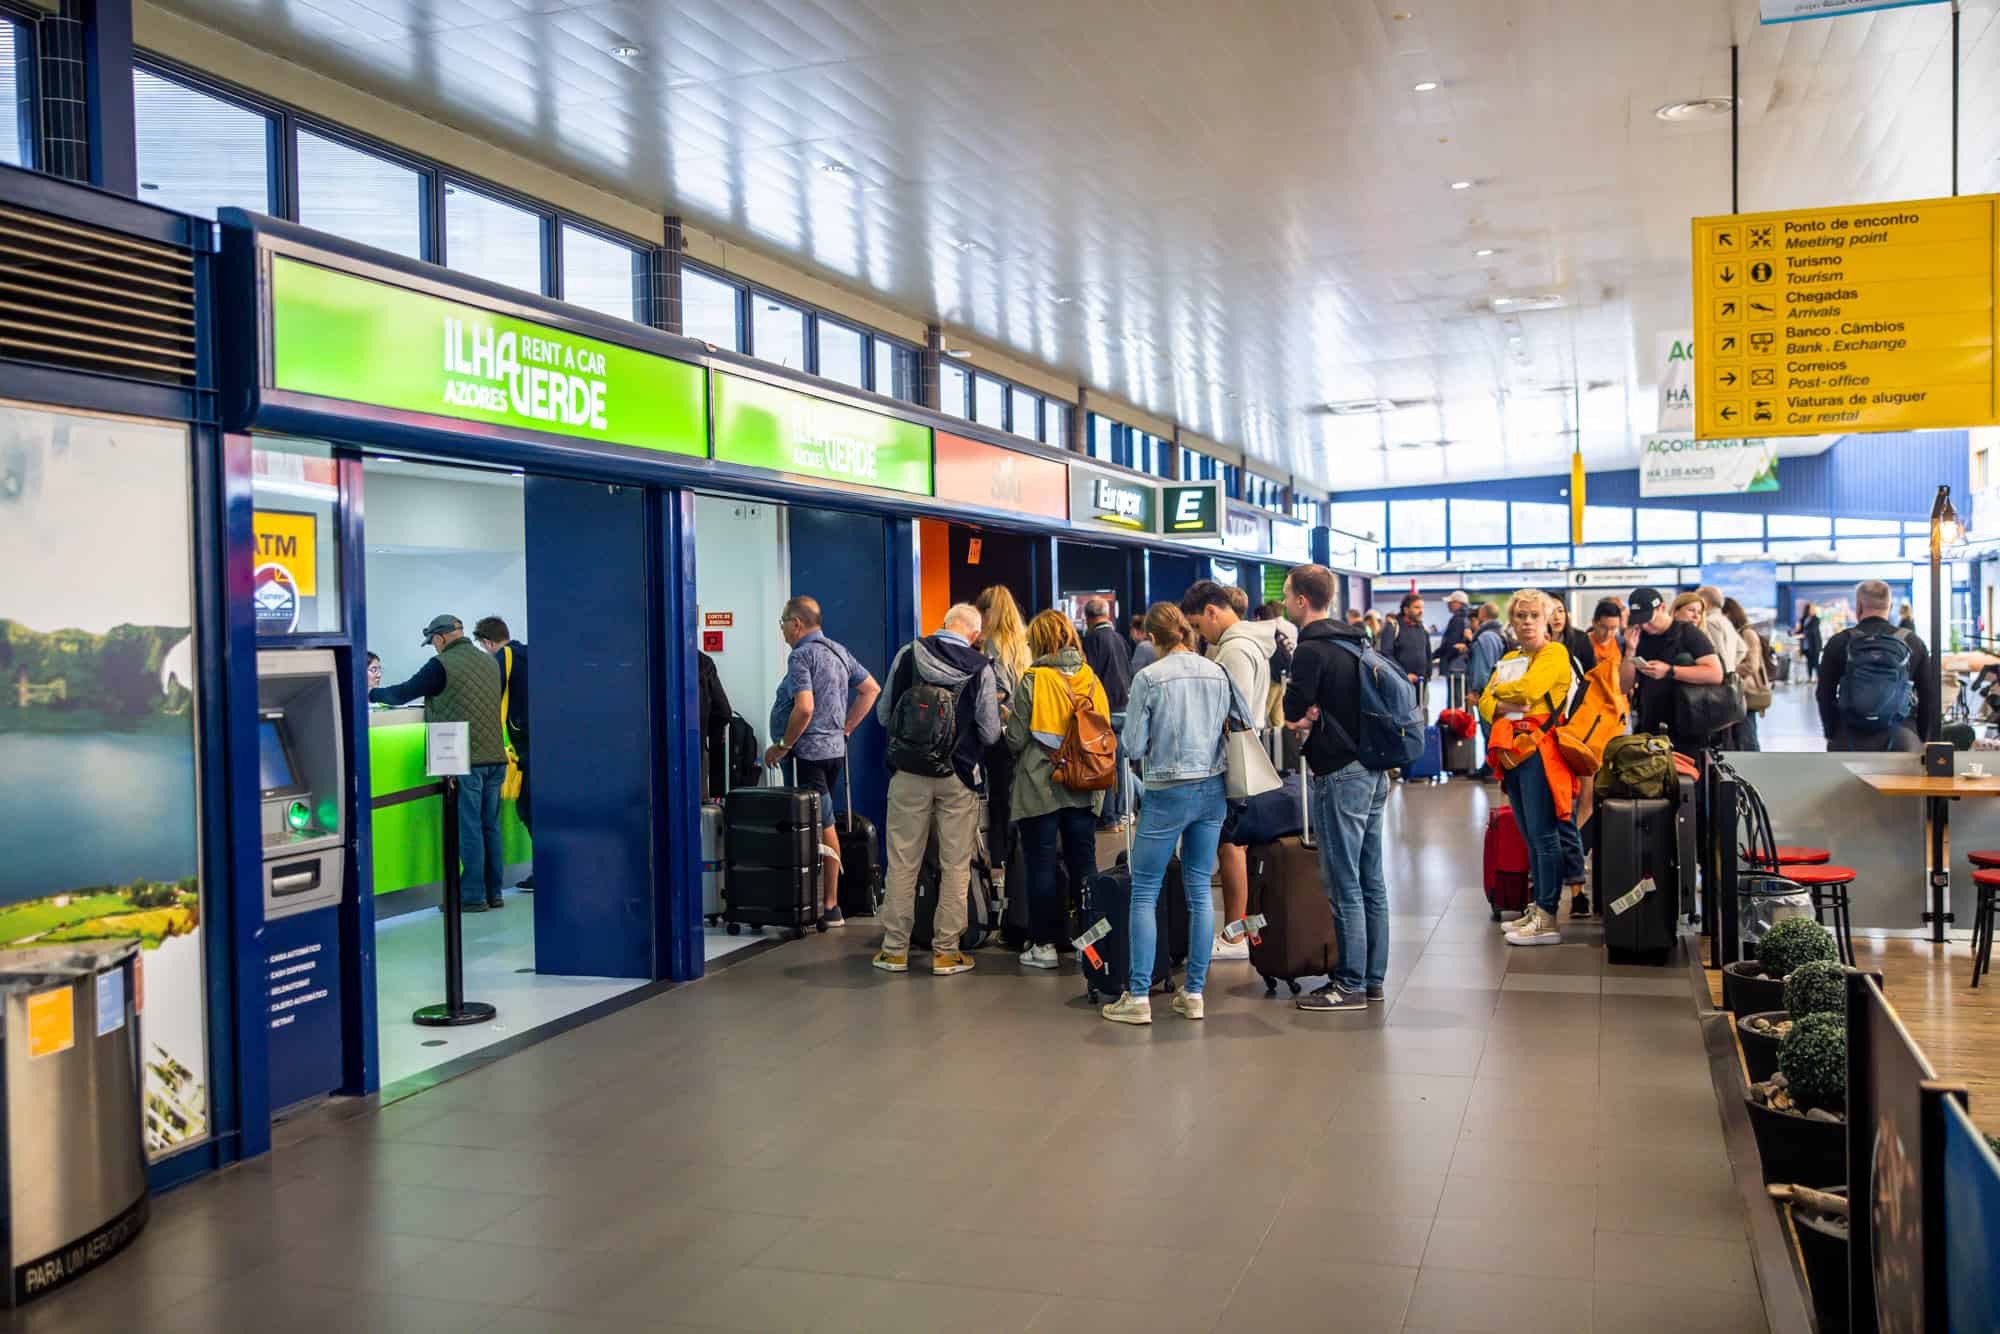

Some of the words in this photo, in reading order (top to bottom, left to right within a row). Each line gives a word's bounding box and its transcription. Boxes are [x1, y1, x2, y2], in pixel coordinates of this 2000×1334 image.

[1784, 220, 1826, 233] Ponto
[1830, 218, 1849, 230] de
[1854, 213, 1919, 228] encontro
[1785, 234, 1845, 249] Meeting
[1849, 231, 1888, 247] point
[1786, 254, 1842, 268] Turismo
[1786, 270, 1844, 285] Tourism
[1786, 288, 1858, 304] Chegadas
[1787, 305, 1841, 320] Arrivals
[1785, 326, 1831, 338] Banco
[1841, 321, 1905, 336] Câmbios
[445, 319, 517, 381] ILHA
[1786, 342, 1822, 355] Bank
[1833, 338, 1906, 352] Exchange
[521, 335, 562, 367] RENT
[564, 345, 575, 370] A
[577, 350, 607, 377] CAR
[1786, 359, 1847, 373] Correios
[1788, 374, 1870, 389] Post-office
[443, 379, 508, 413] AZORES
[509, 366, 608, 430] VERDE
[1786, 394, 1844, 408] Viaturas
[1849, 393, 1867, 405] de
[1872, 390, 1927, 406] aluguer
[1787, 411, 1812, 424] Car
[1817, 409, 1860, 423] rental
[1175, 490, 1204, 522] E
[25, 1257, 65, 1293] PARA
